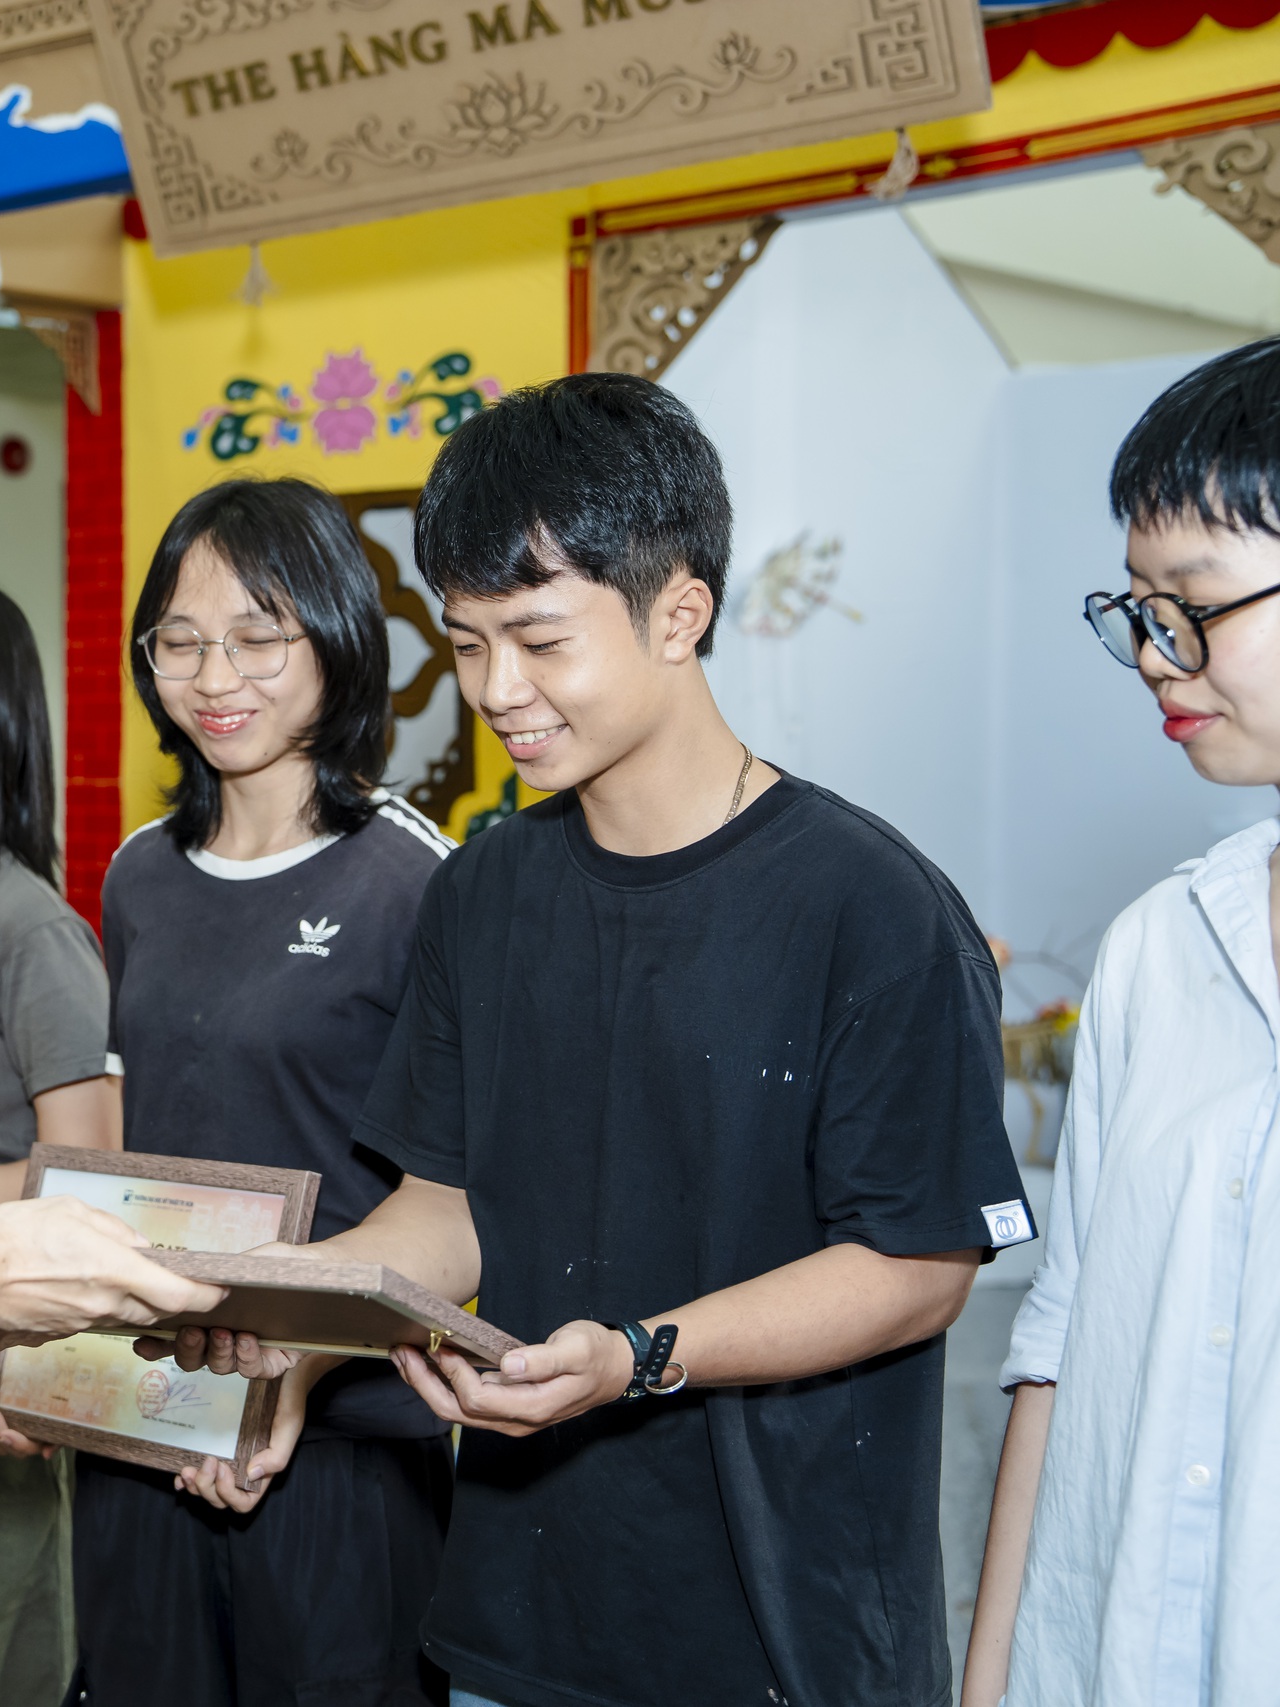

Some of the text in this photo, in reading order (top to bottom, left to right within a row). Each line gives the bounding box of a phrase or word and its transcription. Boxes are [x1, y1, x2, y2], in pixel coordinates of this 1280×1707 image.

[171, 60, 276, 117] THE
[288, 21, 447, 92] HÀNG
[288, 942, 330, 957] adidas
